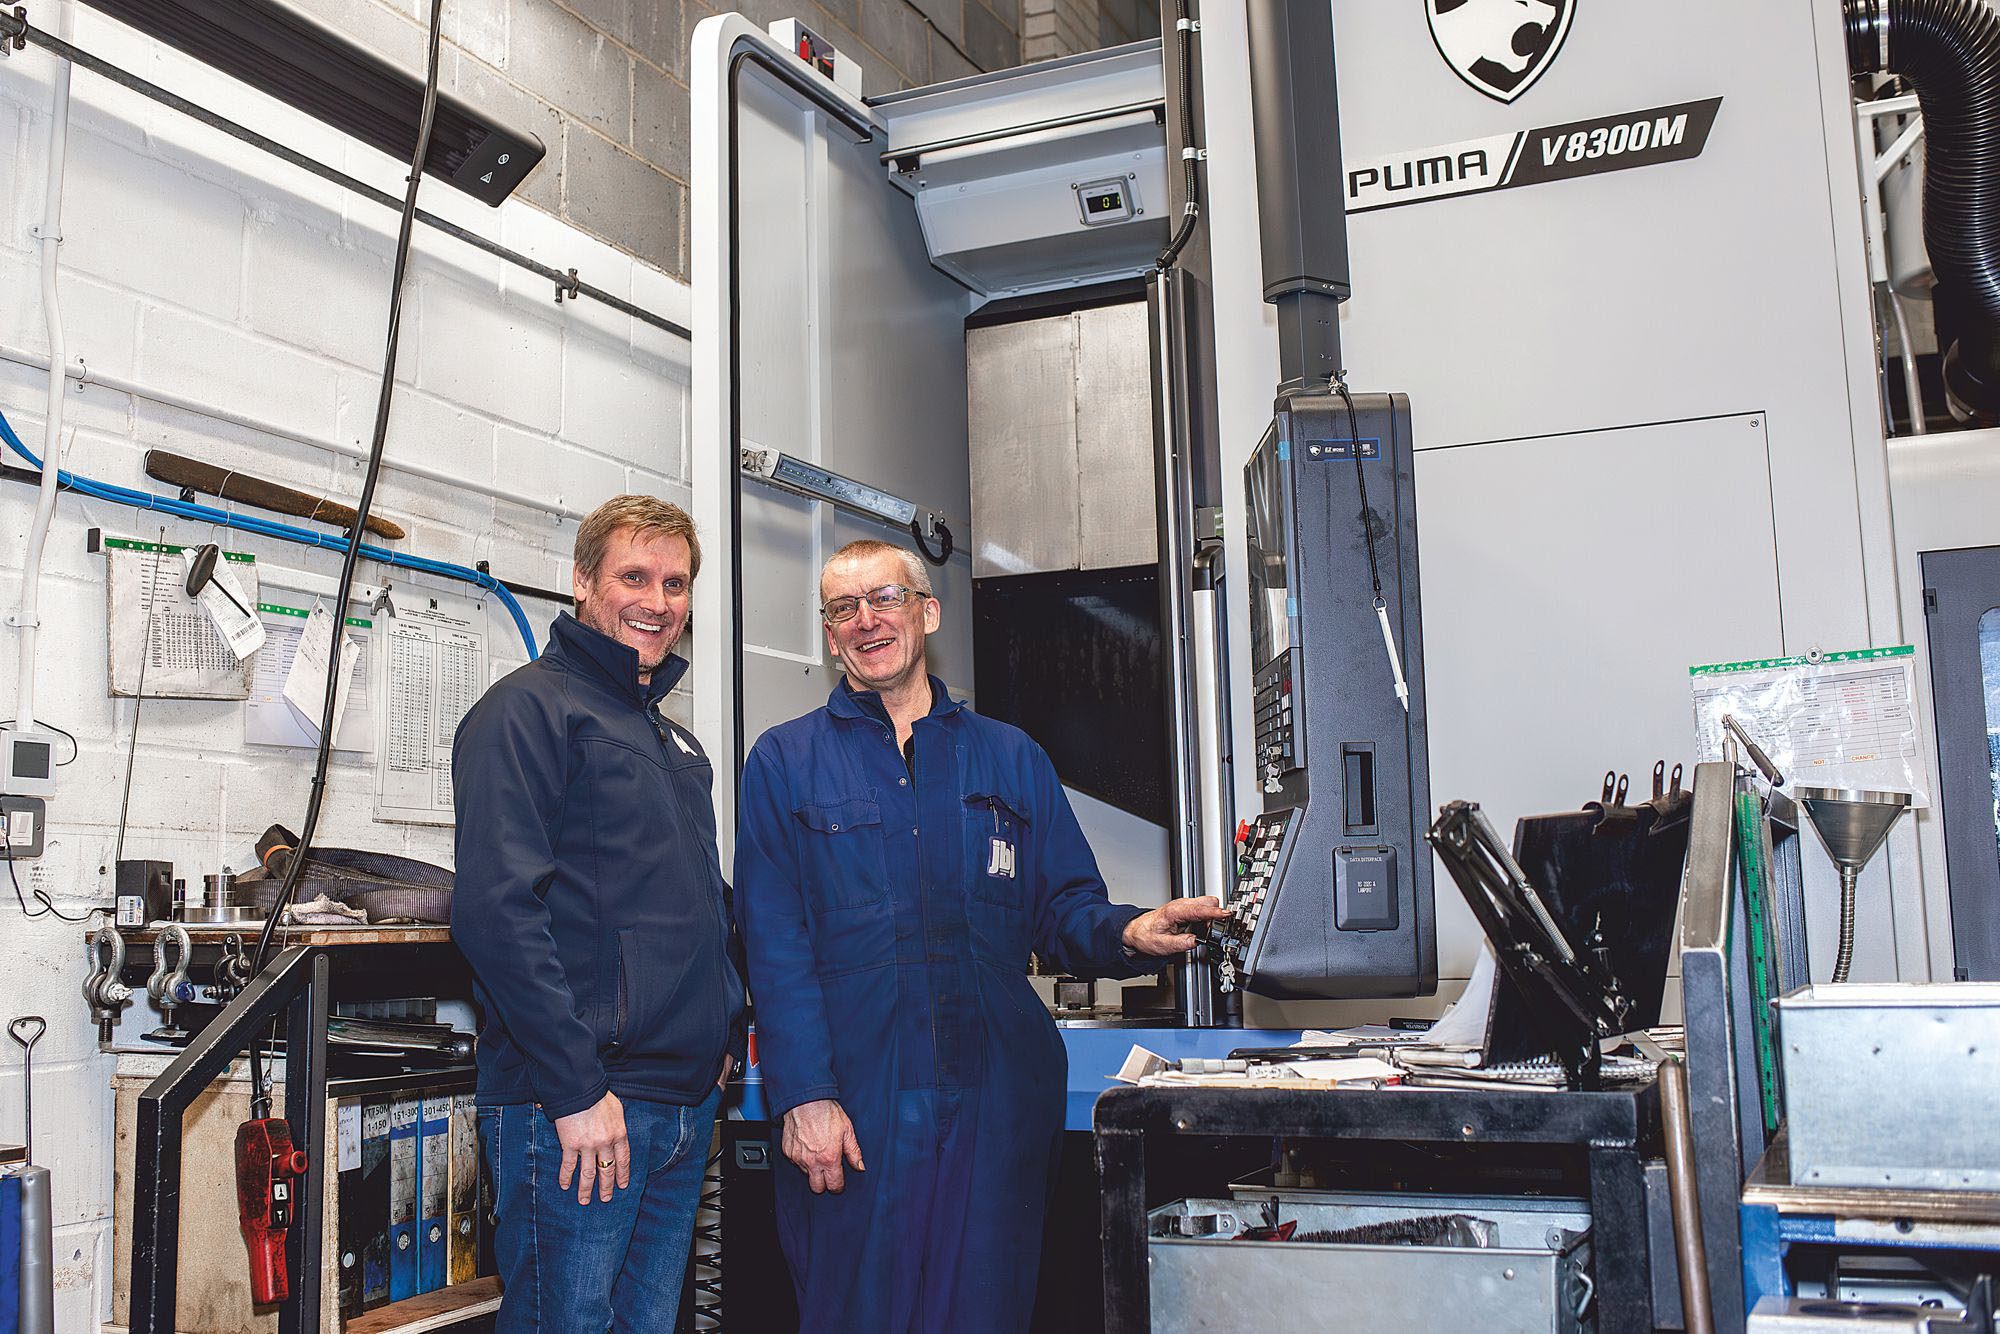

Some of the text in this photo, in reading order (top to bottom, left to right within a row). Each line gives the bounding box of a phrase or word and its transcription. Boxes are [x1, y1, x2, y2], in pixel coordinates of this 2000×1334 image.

[1348, 113, 1688, 197] PUMA V8300M
[1851, 754, 1875, 762] CHANGE
[362, 1103, 390, 1118] VT750M
[393, 1106, 418, 1121] 151-300
[424, 1103, 449, 1116] 301-450
[367, 1119, 387, 1132] 1-150
